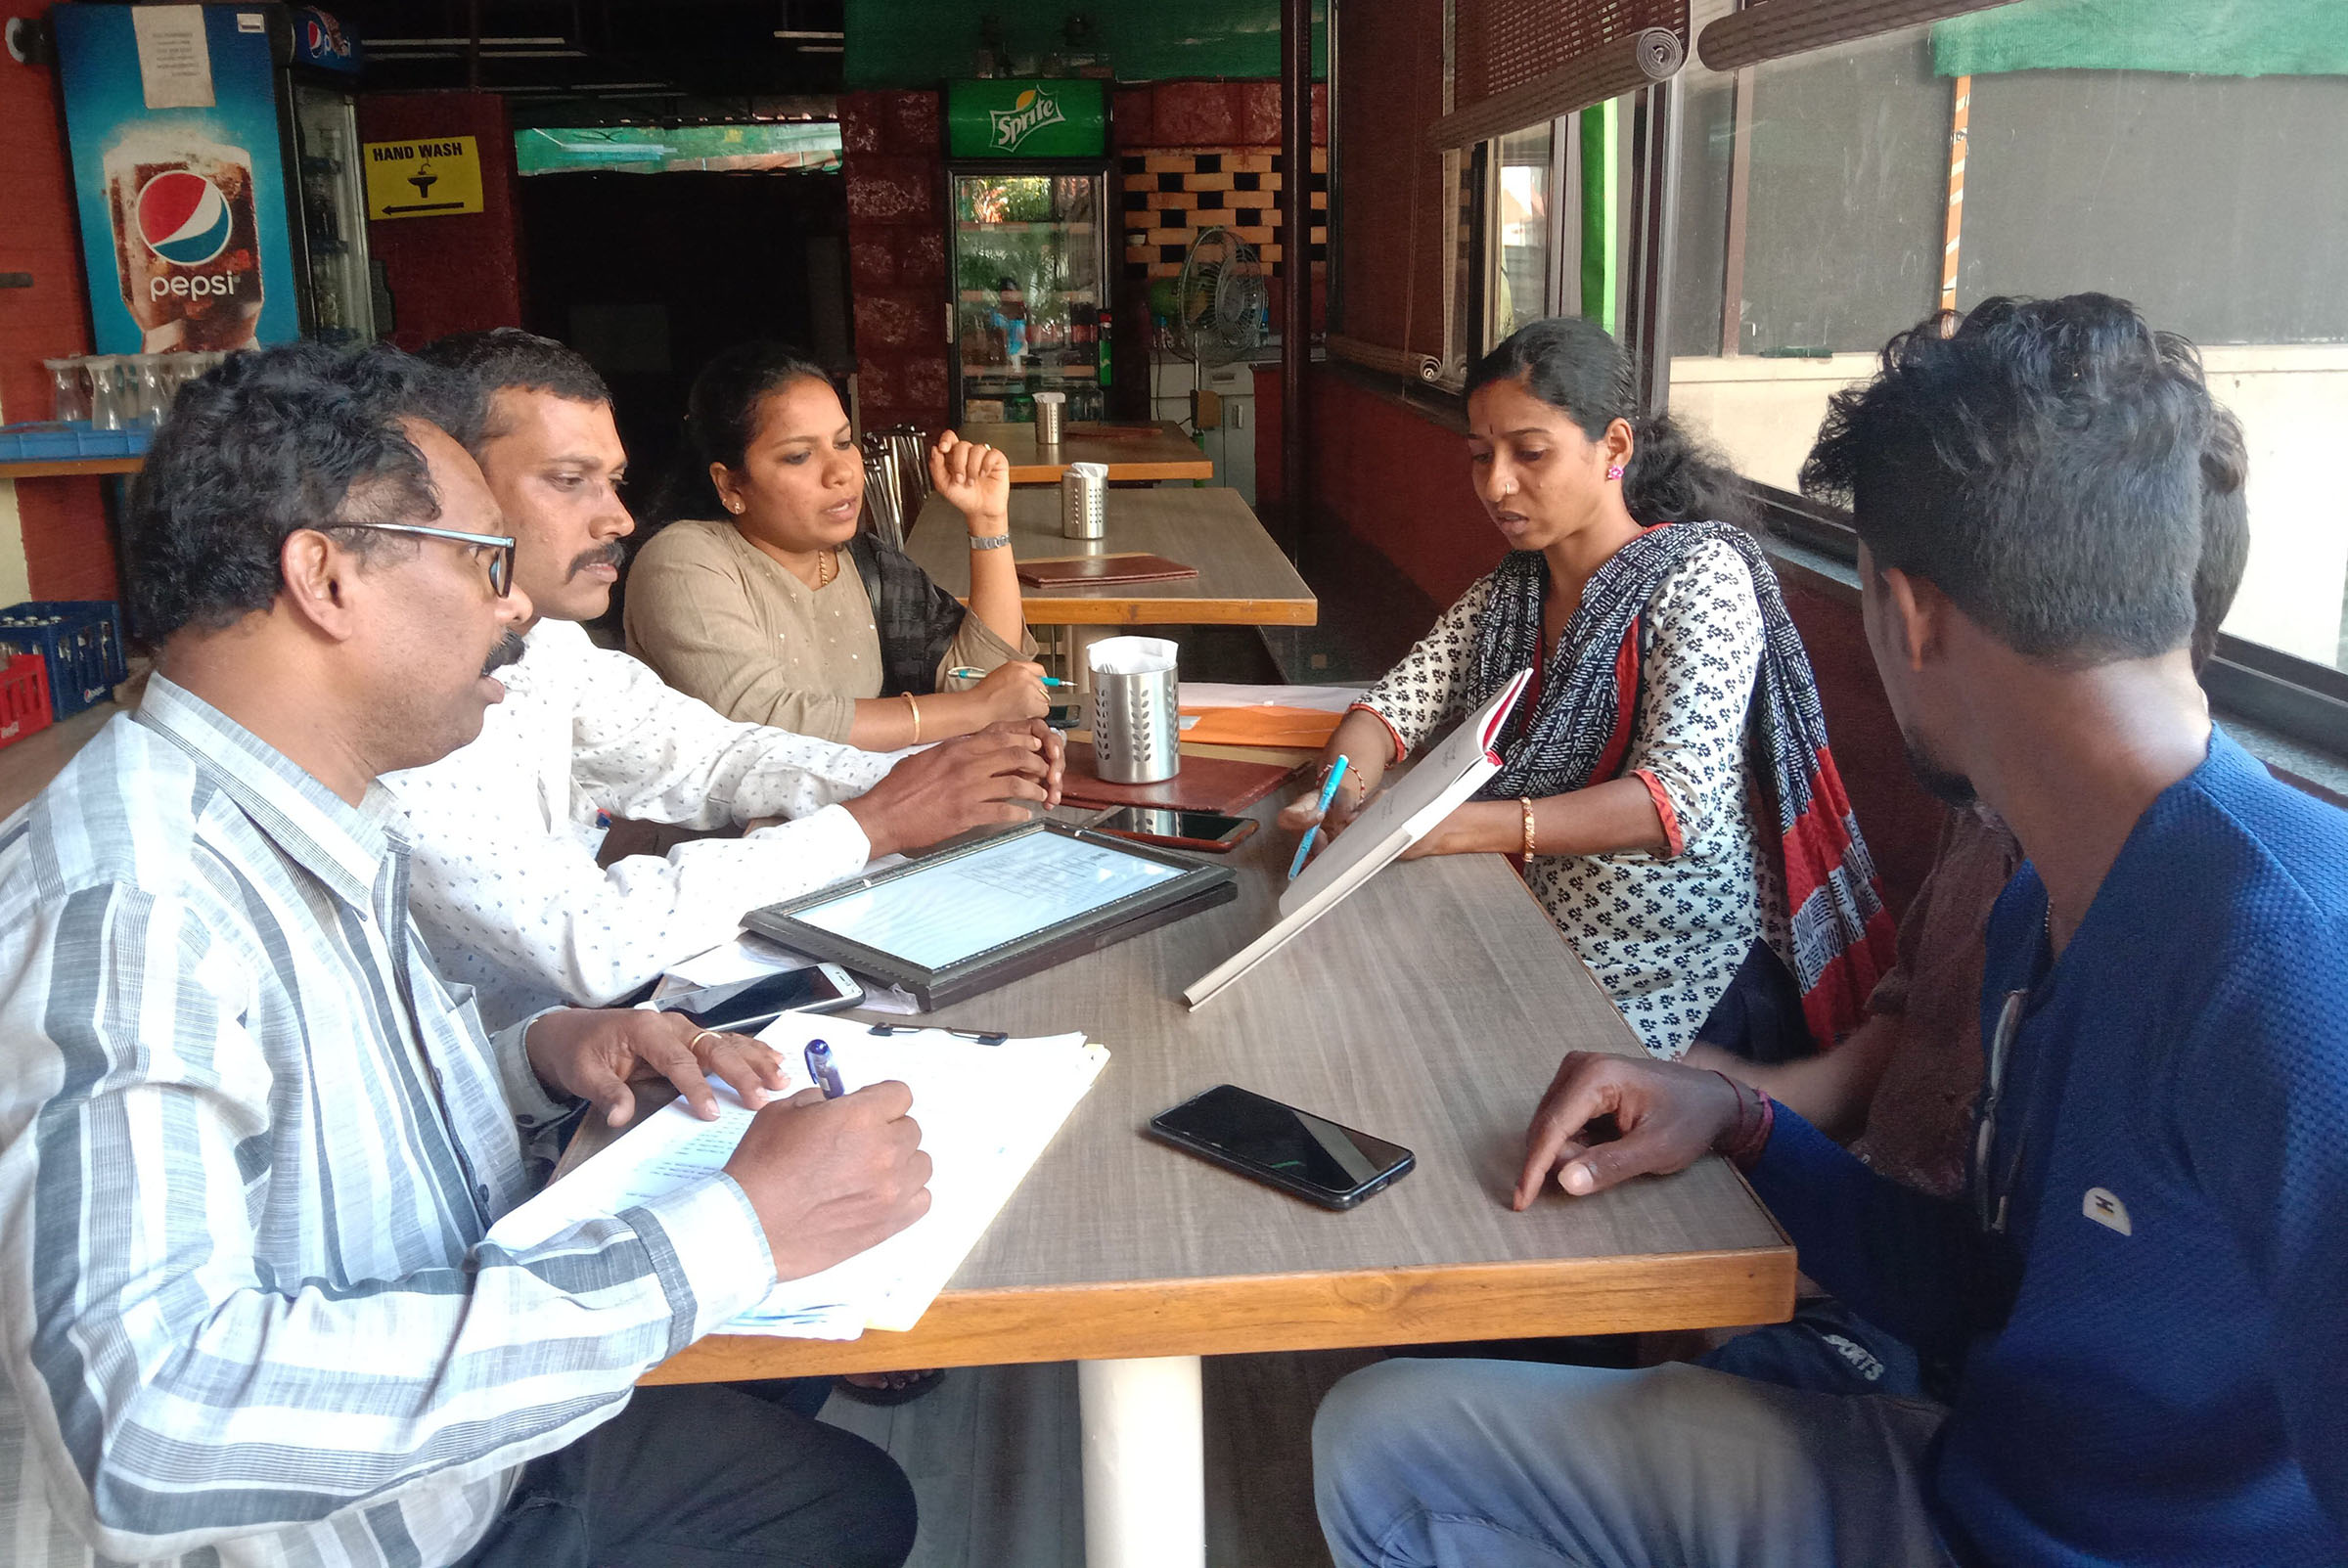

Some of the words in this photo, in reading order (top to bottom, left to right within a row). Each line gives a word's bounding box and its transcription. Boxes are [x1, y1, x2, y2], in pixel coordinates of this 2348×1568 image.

[998, 95, 1055, 145] Sprite
[373, 146, 414, 161] HAND
[418, 142, 463, 158] WASH
[150, 270, 235, 301] pepsi
